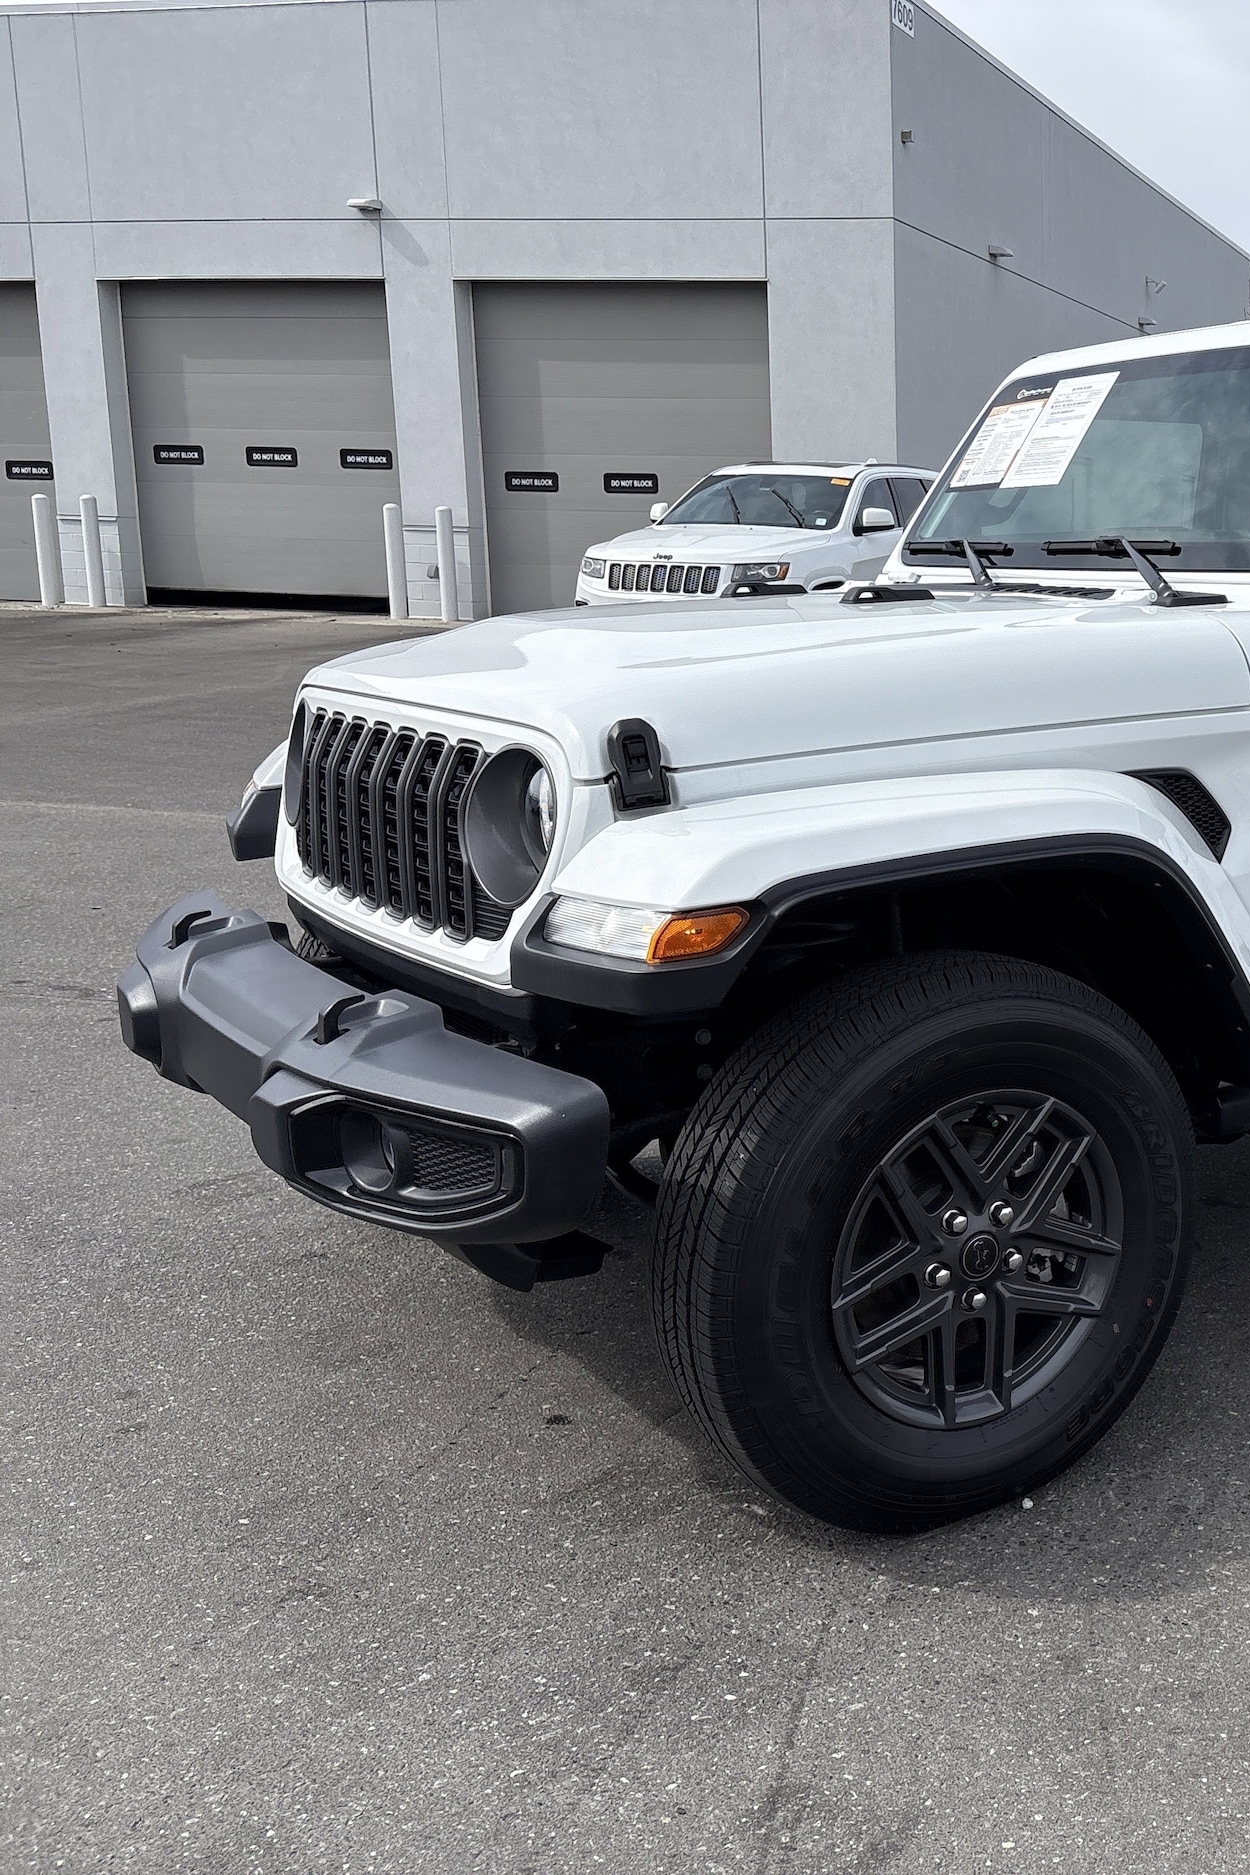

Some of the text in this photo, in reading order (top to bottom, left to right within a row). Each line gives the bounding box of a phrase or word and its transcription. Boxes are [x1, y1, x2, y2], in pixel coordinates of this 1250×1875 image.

[160, 451, 199, 459] DO NOT BLOCK
[253, 453, 292, 461] DO NOT BLOCK
[347, 455, 387, 463] DO NOT BLOCK
[12, 466, 49, 474] DO NOT BLOCK
[512, 478, 553, 486] DO NOT BLOCK
[611, 479, 653, 487] DO NOT BLOCK
[653, 553, 673, 561] Jeep
[1065, 1084, 1183, 1442] BRIDGESTONE
